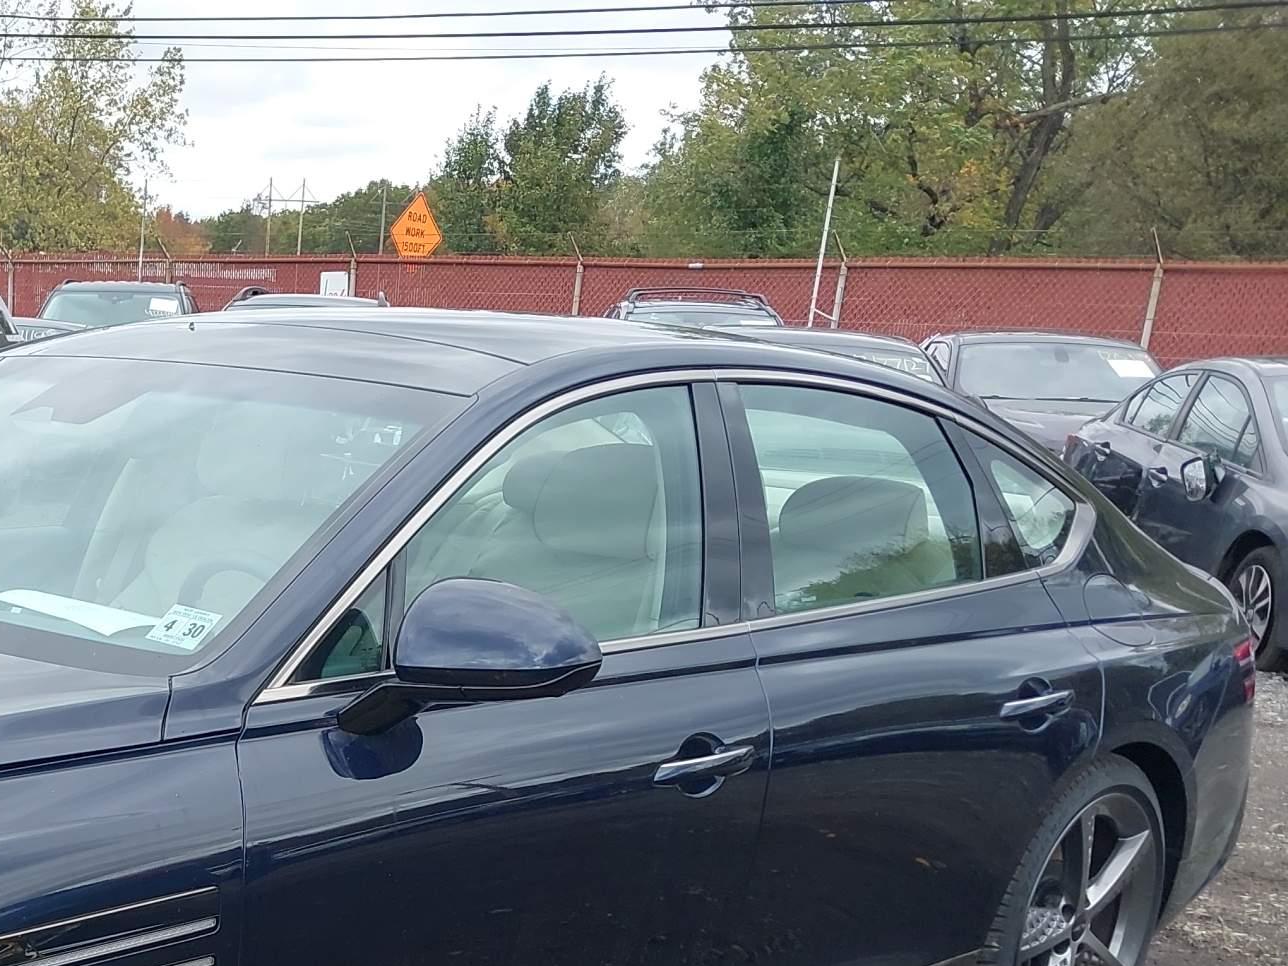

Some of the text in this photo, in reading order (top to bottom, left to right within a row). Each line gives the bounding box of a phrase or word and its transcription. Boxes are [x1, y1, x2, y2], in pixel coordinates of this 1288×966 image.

[407, 210, 428, 224] ROAD
[405, 226, 425, 239] WORK
[163, 619, 206, 639] 4 30
